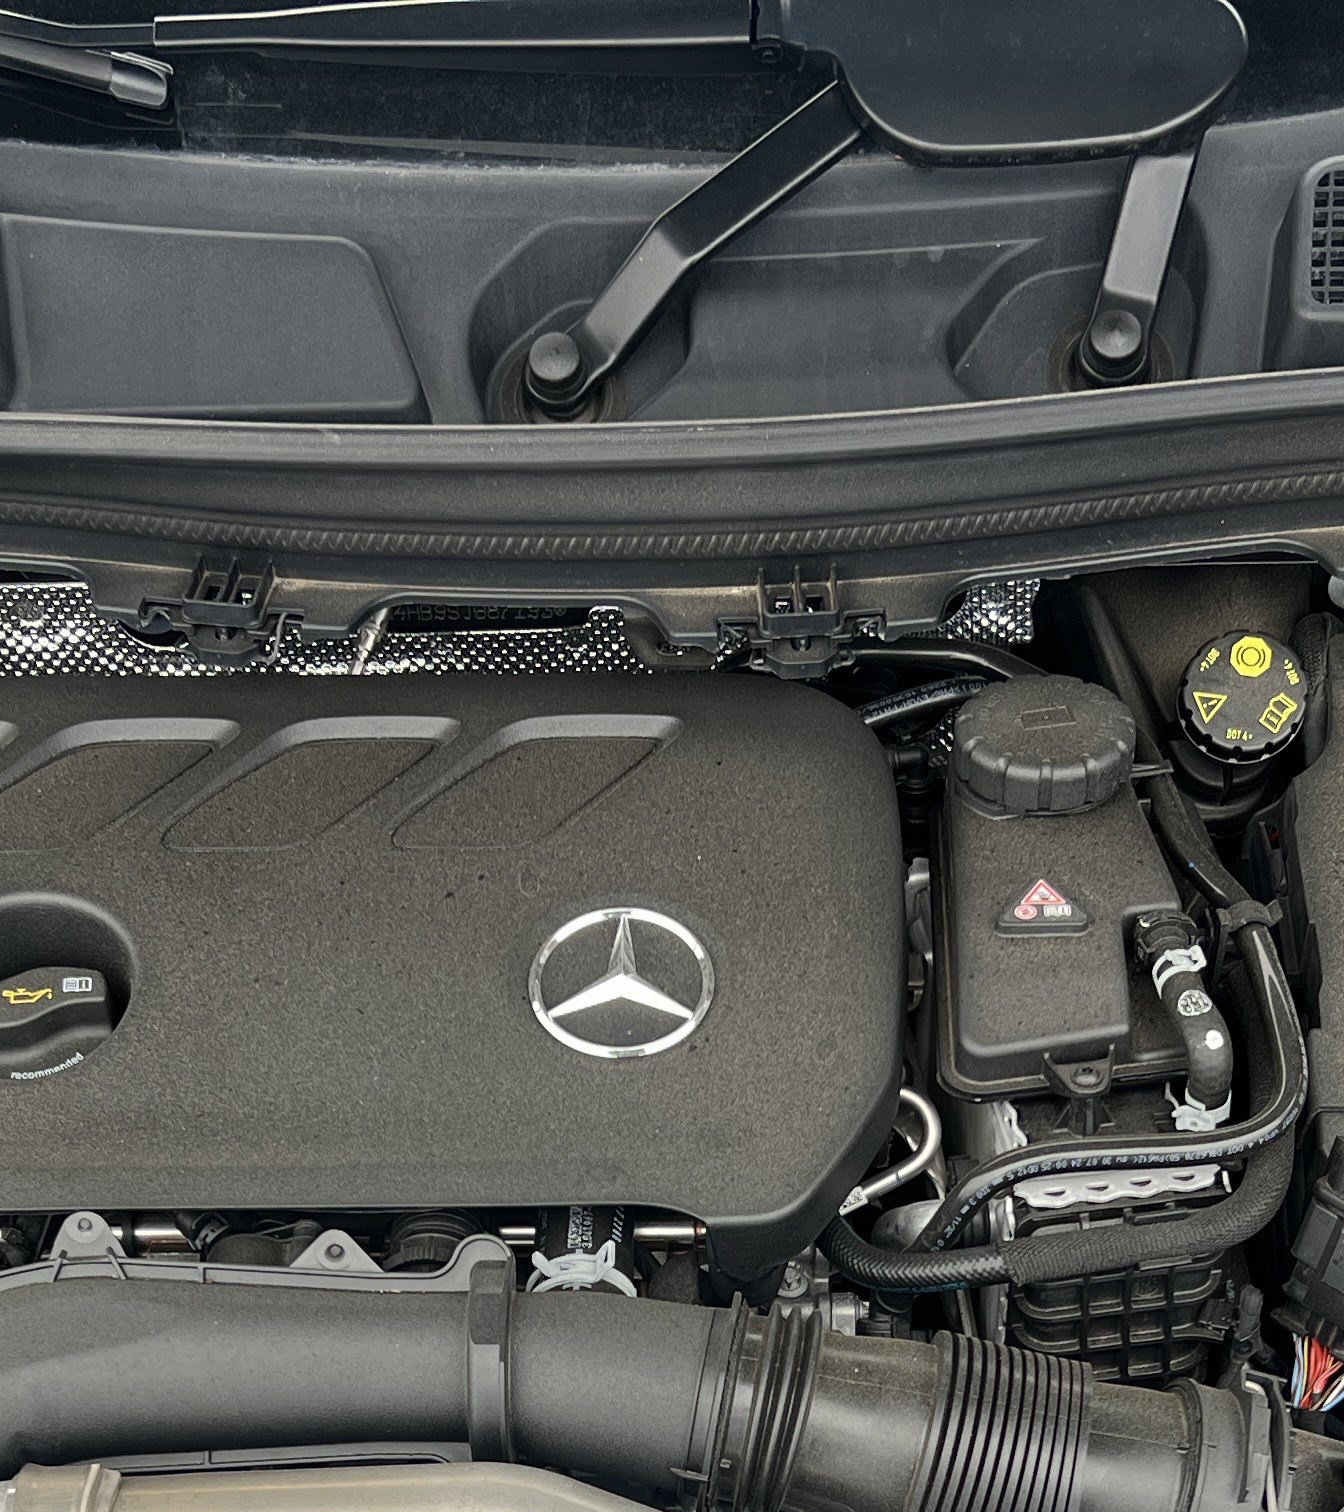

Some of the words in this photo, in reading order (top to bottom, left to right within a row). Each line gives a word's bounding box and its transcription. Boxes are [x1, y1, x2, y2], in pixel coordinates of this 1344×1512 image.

[390, 604, 553, 621] 4HB9SJ687193
[1226, 728, 1242, 740] DOT
[10, 1052, 84, 1080] recommended
